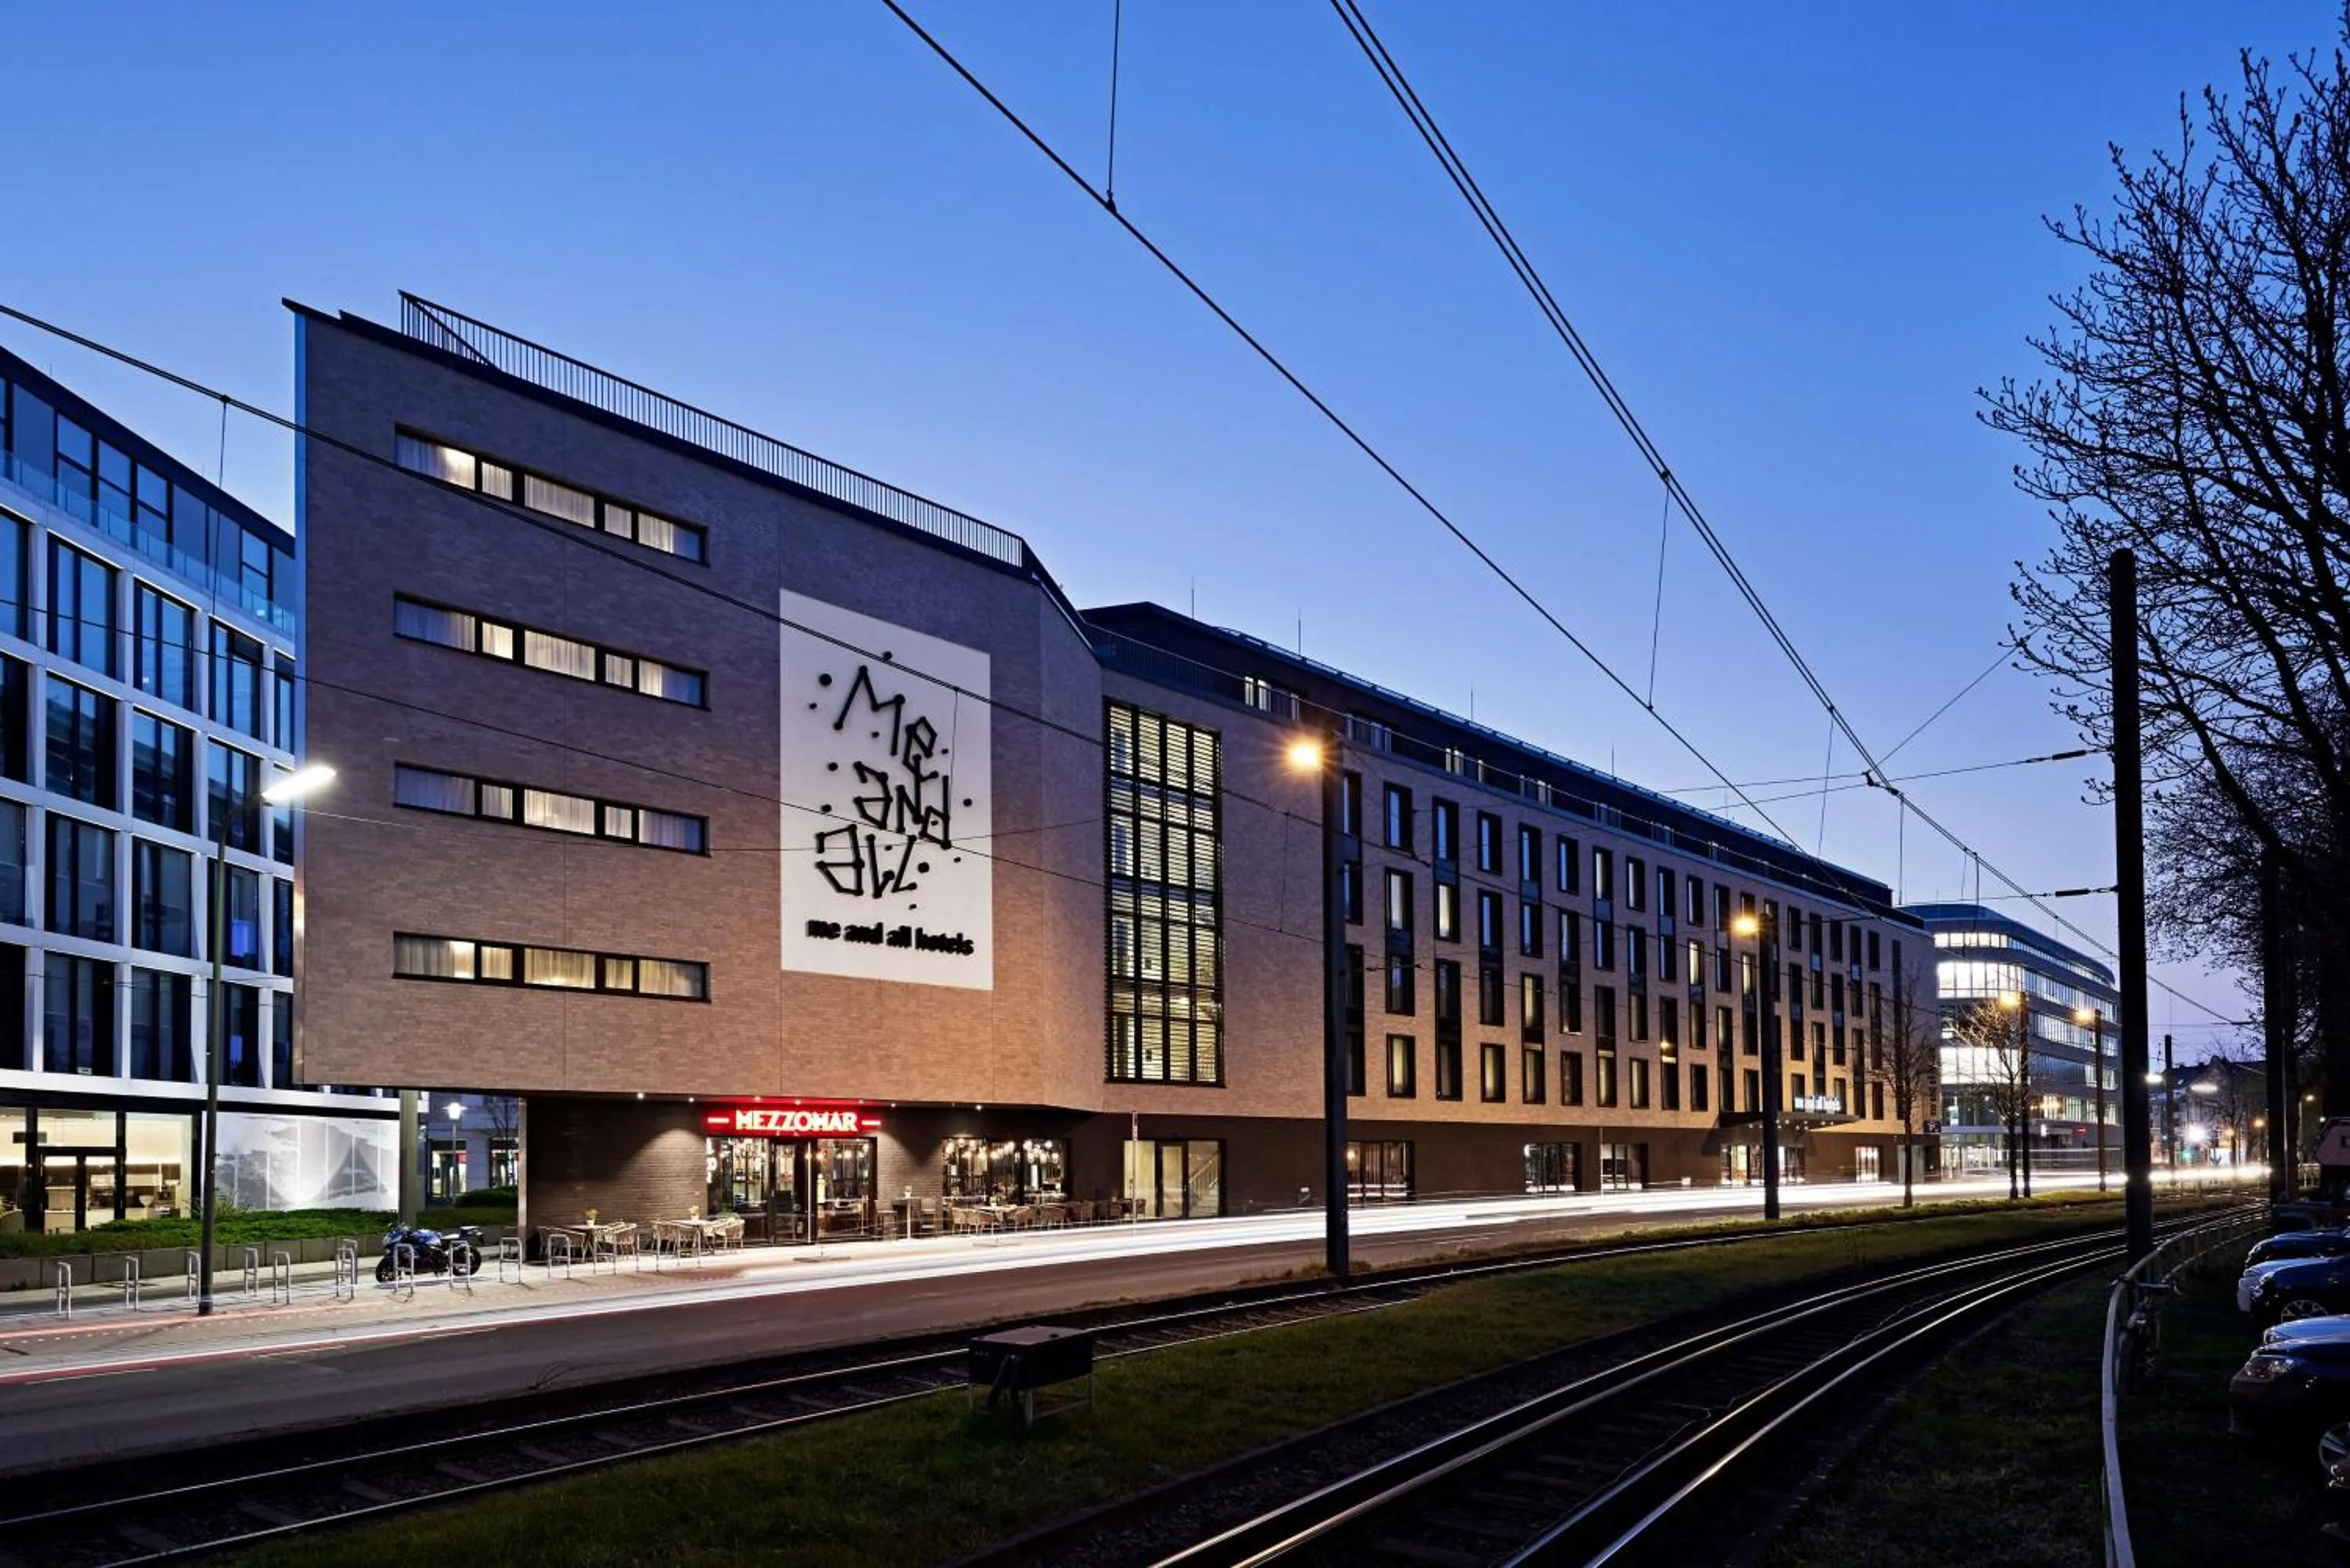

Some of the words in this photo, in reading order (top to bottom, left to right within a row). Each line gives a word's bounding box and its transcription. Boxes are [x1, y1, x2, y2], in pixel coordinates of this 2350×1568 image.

[806, 919, 841, 940] me
[844, 922, 884, 945] and
[886, 925, 912, 948] all
[915, 927, 974, 956] hotels
[736, 1109, 858, 1132] MEZZOMAR
